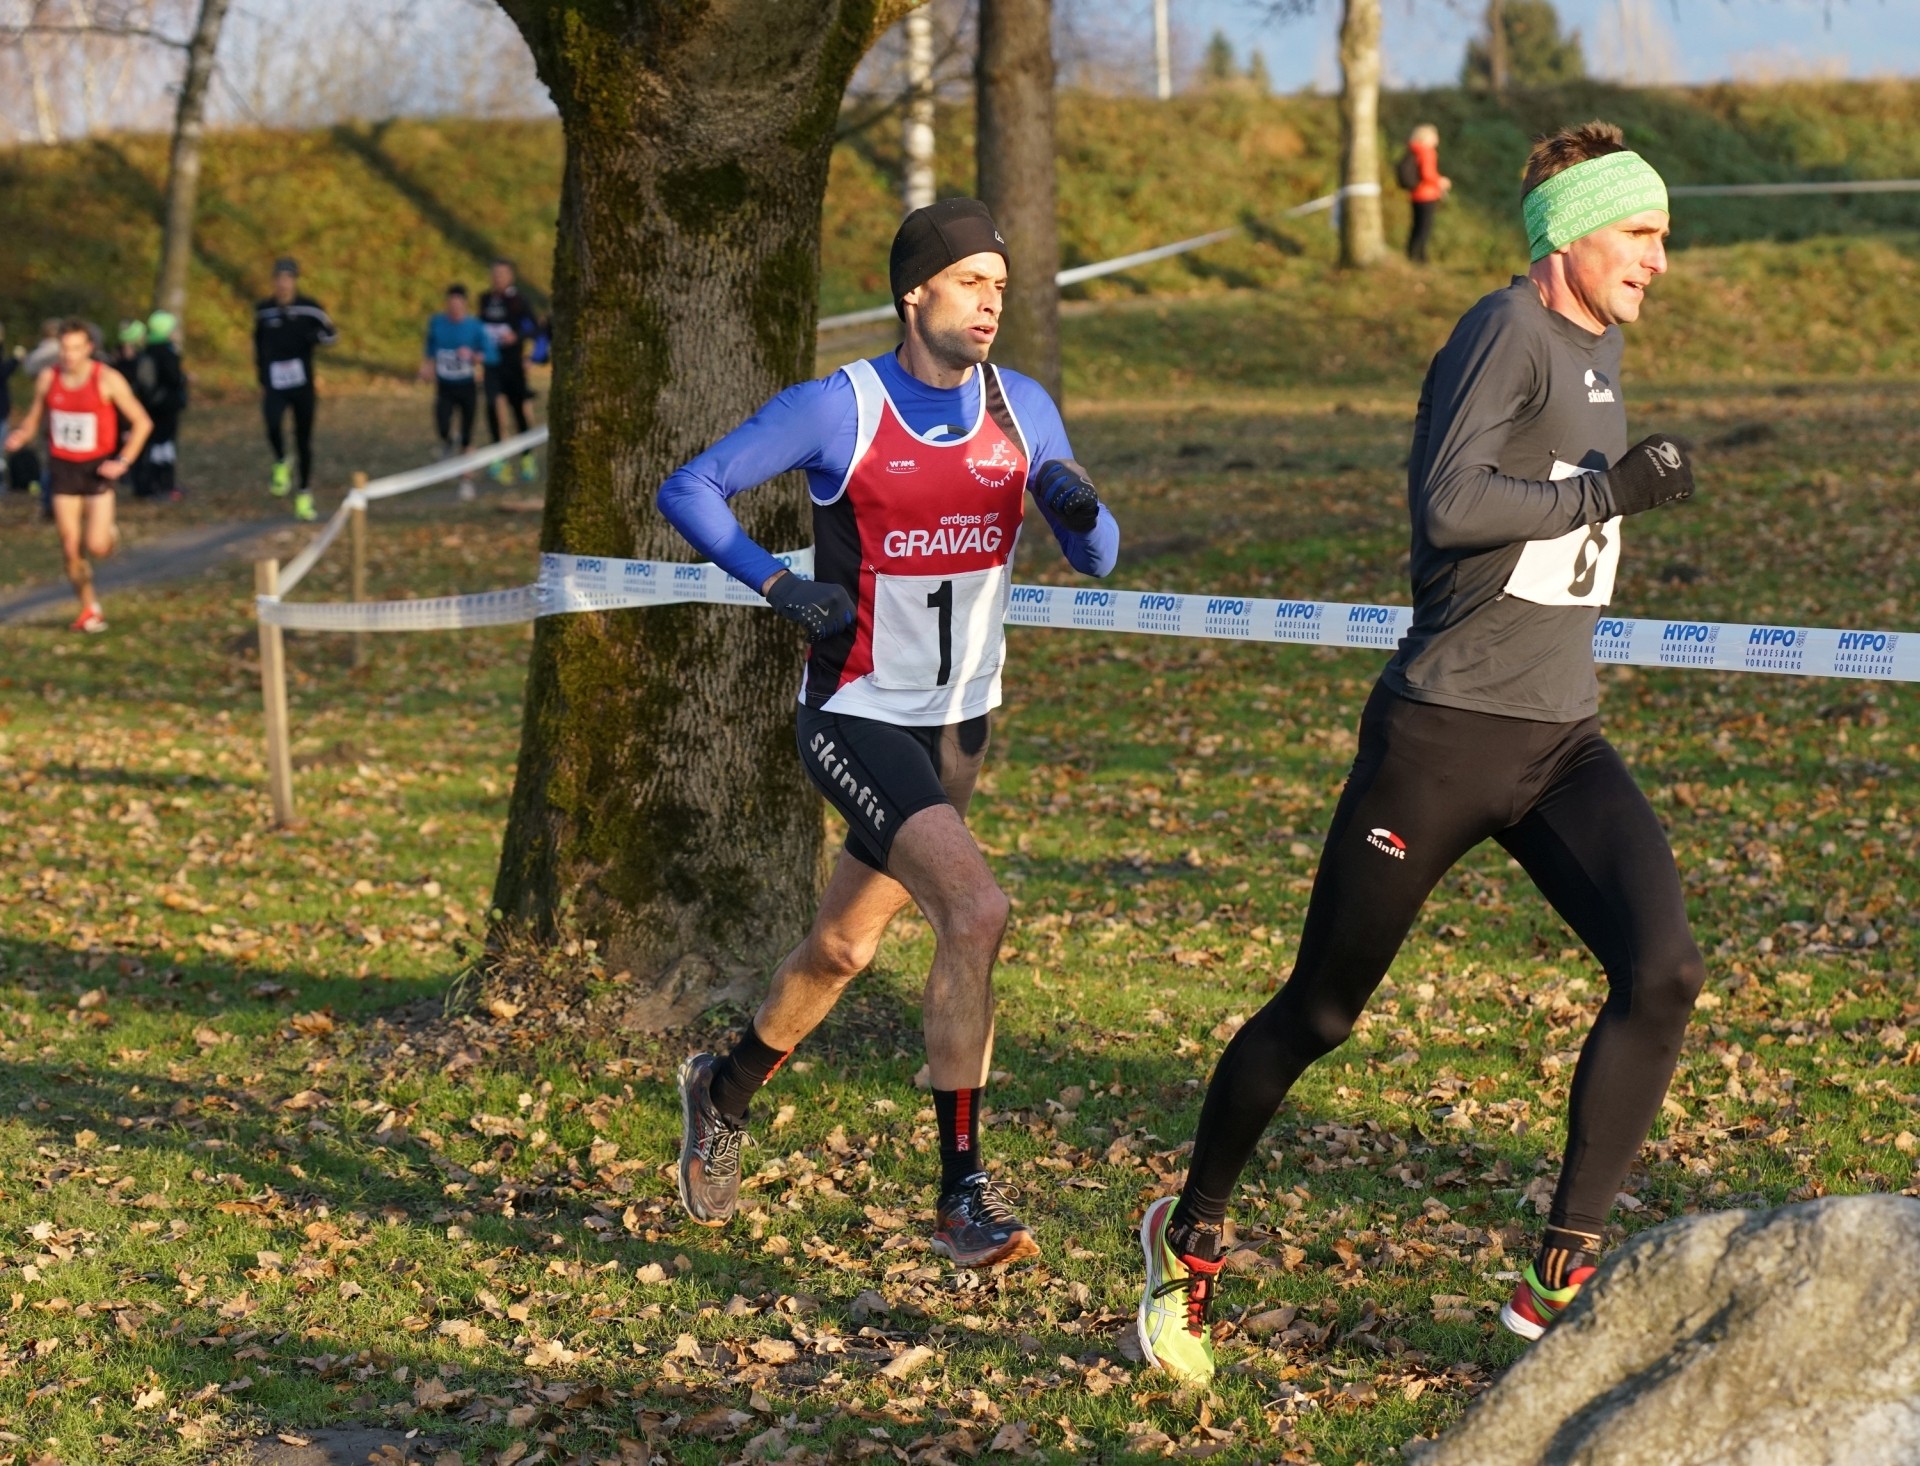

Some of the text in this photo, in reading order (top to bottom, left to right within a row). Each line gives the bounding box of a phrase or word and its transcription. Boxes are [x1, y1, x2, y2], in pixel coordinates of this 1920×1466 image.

[1556, 164, 1627, 207] skinfit
[1570, 192, 1641, 238] skinfit
[1588, 389, 1615, 403] skinfit
[965, 457, 1018, 488] RHEINTAL
[940, 513, 981, 526] erdgas
[884, 526, 1003, 558] GRAVAG
[576, 558, 602, 573] HYPO
[624, 562, 651, 577] HYPO
[674, 566, 702, 581] HYPO
[1011, 588, 1045, 604] HYPO
[1074, 591, 1109, 607] HYPO
[1139, 595, 1175, 611] HYPO
[1073, 608, 1114, 617] LANDESBANK
[1207, 599, 1244, 616] HYPO
[1276, 603, 1315, 620] HYPO
[1073, 617, 1114, 626] VORARLBERG
[1138, 612, 1181, 622] LANDESBANK
[1205, 617, 1250, 626] LANDESBANK
[1348, 607, 1388, 624] HYPO
[1138, 621, 1181, 632] VORARLBERG
[1205, 626, 1250, 636] VORARLBERG
[1274, 620, 1320, 630] LANDESBANK
[1347, 624, 1394, 635] LANDESBANK
[927, 580, 953, 687] 1
[1274, 630, 1320, 640] VORARLBERG
[1346, 634, 1394, 645] VORARLBERG
[1663, 624, 1709, 643] HYPO
[1749, 628, 1796, 647] HYPO
[1594, 639, 1631, 649] DESBANK
[1660, 643, 1716, 654] LANDESBANK
[1838, 633, 1886, 652] HYPO
[1660, 654, 1714, 665] VORARLBERG
[1746, 648, 1803, 659] LANDESBANK
[1835, 653, 1894, 664] LANDESBANK
[1745, 658, 1801, 670] VORARLBERG
[1834, 663, 1892, 675] VORARLBERG
[810, 732, 885, 831] skinfit
[1366, 834, 1406, 860] skinfit
